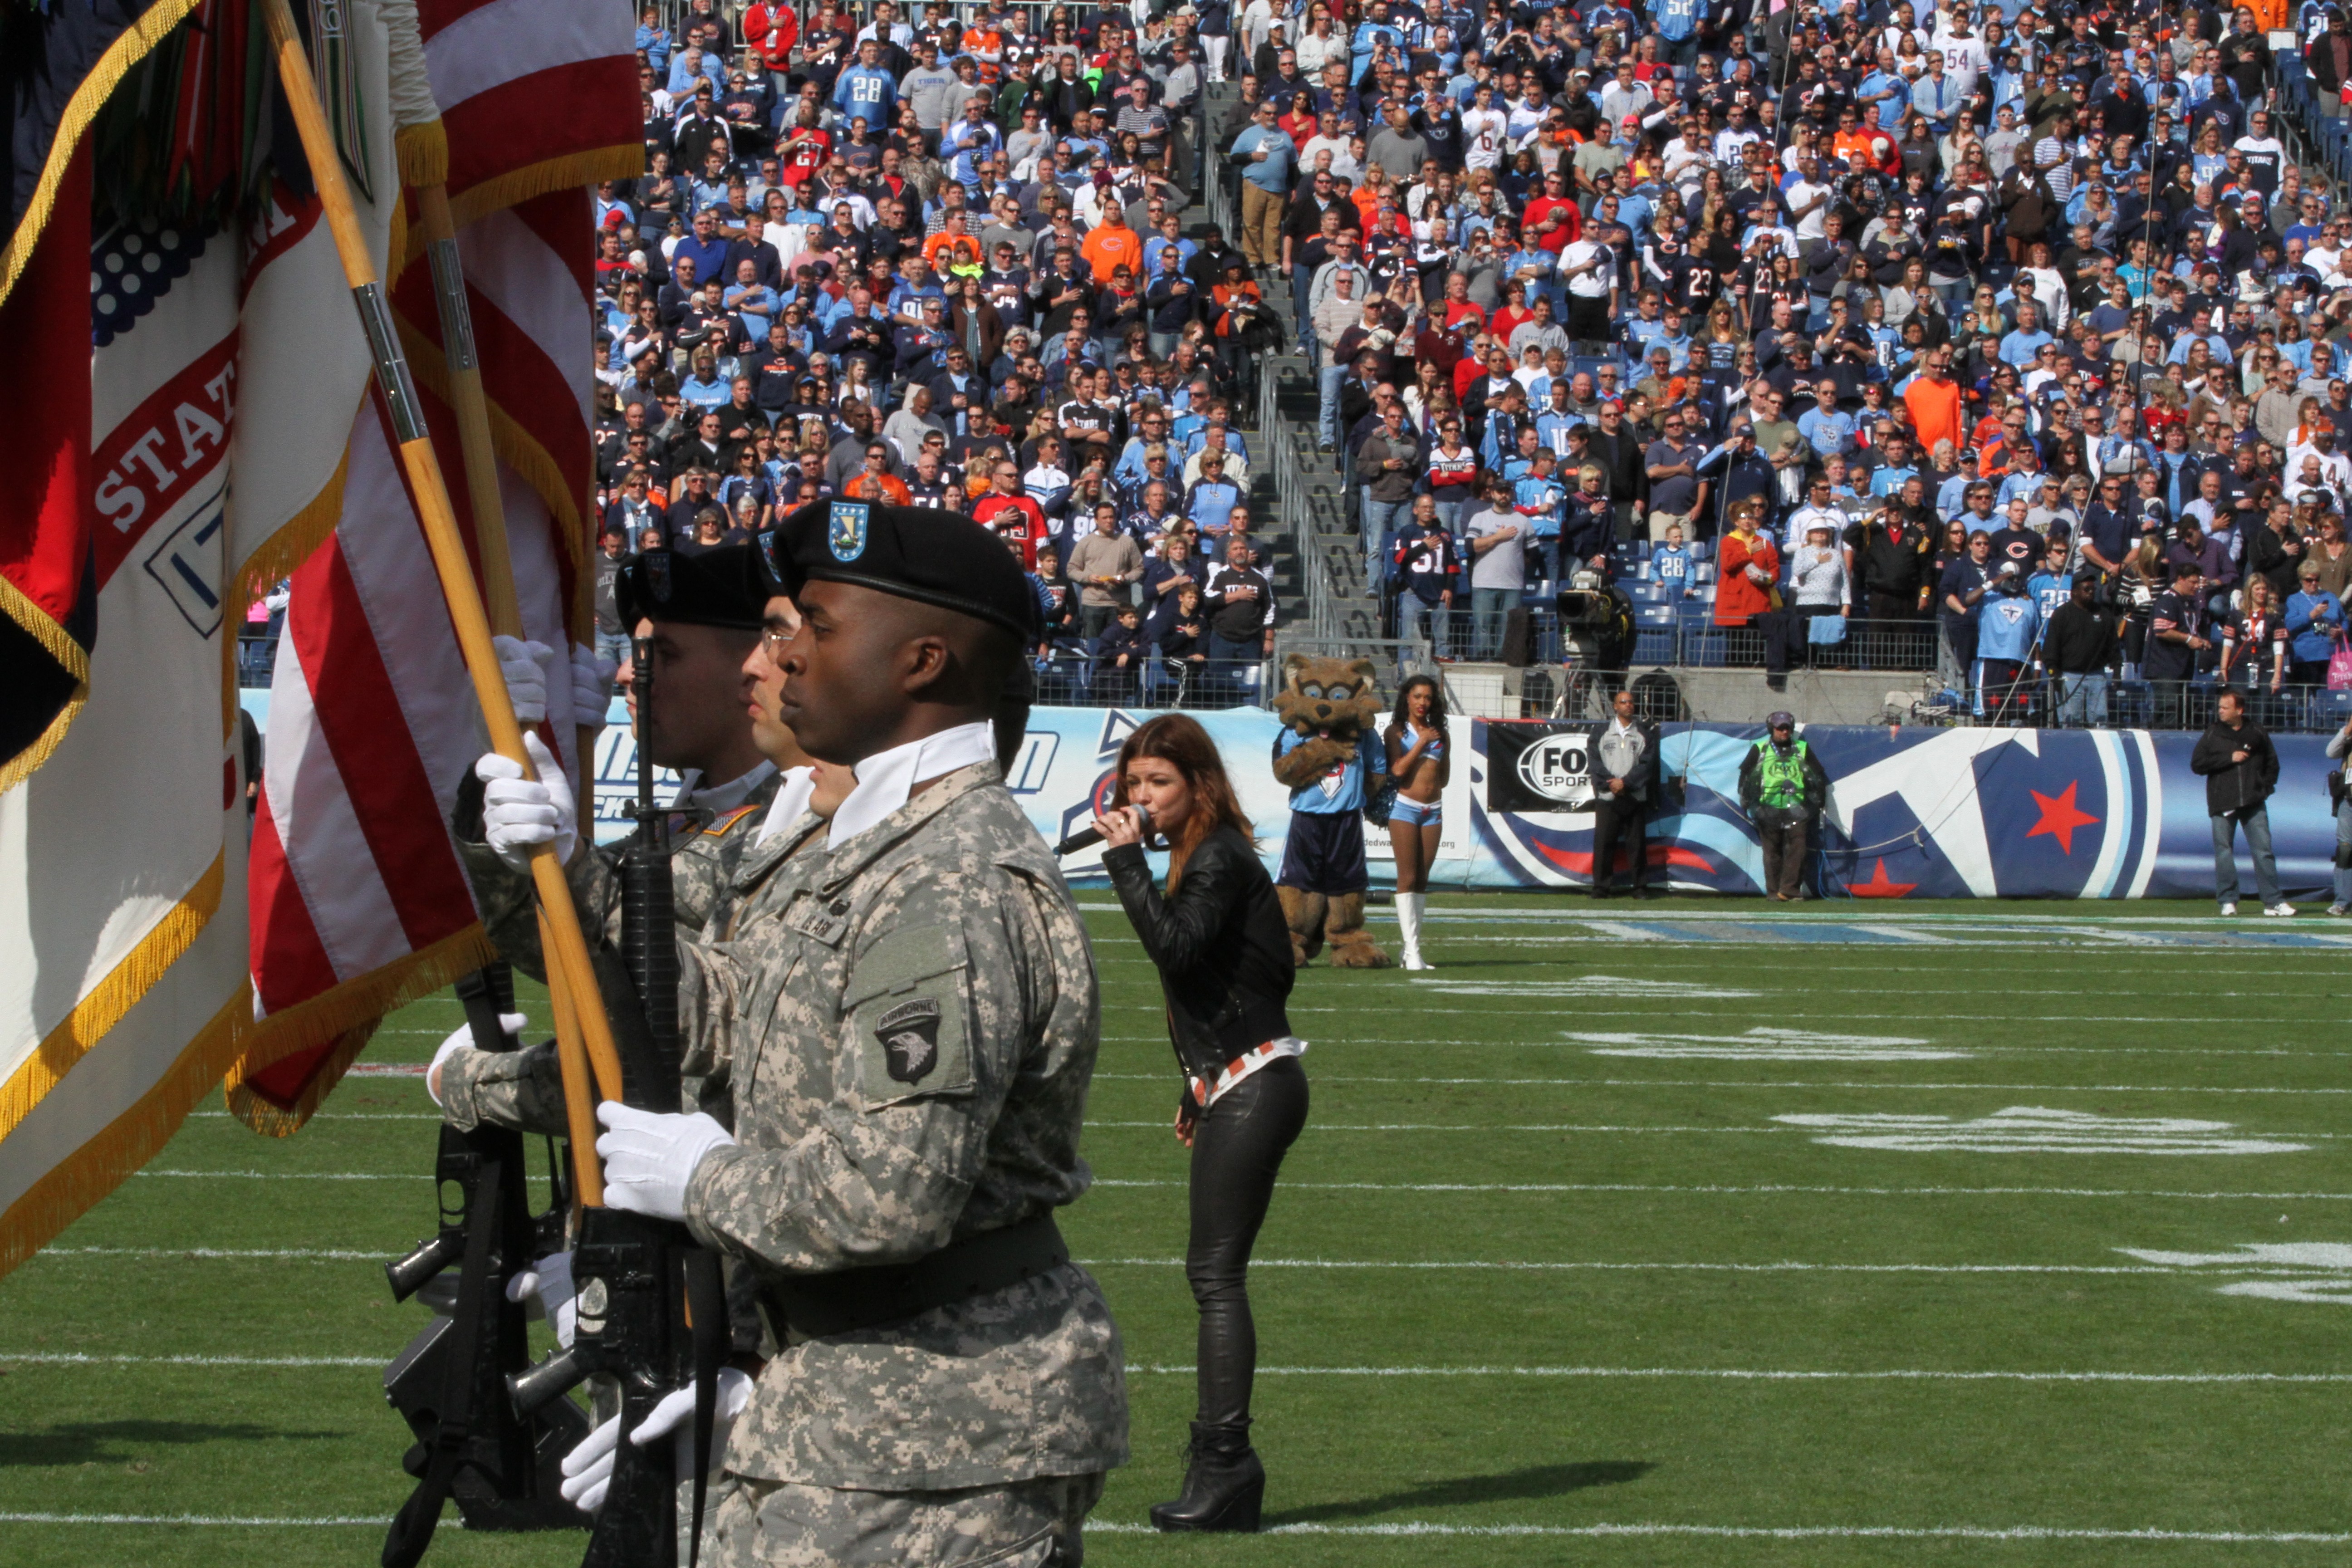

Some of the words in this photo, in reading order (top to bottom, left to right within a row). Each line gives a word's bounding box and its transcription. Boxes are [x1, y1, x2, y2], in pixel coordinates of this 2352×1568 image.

[1948, 49, 1969, 70] 54
[853, 77, 882, 103] 28
[796, 142, 823, 166] 27
[2246, 156, 2274, 166] TITANS
[1689, 268, 1712, 296] 23
[1754, 268, 1772, 293] 23
[2210, 306, 2225, 333] 4
[94, 360, 239, 534] STAT
[2325, 463, 2337, 482] 4
[2006, 541, 2028, 559] C
[1661, 558, 1684, 578] 28
[1544, 748, 1589, 775] FO
[1544, 777, 1590, 786] SPOR
[880, 1002, 934, 1027] AIRBORNE
